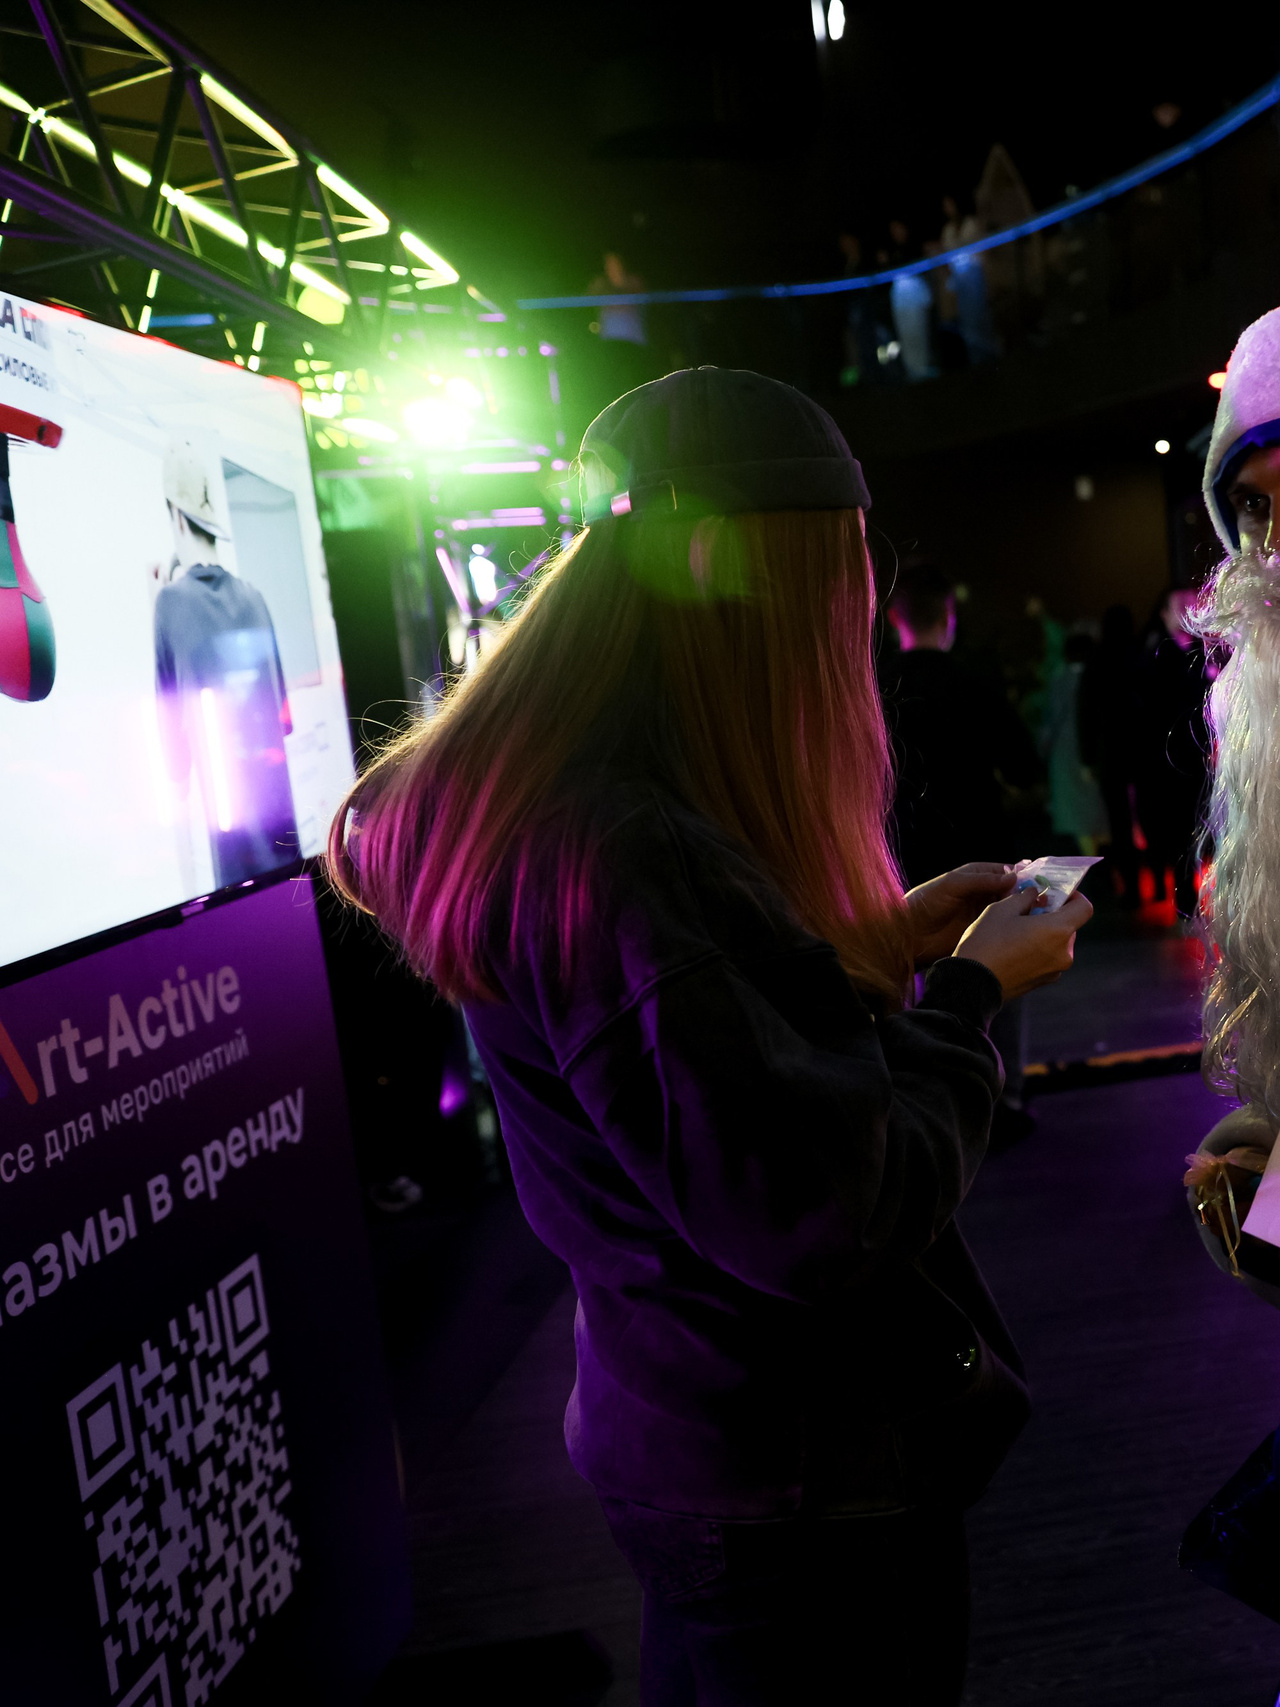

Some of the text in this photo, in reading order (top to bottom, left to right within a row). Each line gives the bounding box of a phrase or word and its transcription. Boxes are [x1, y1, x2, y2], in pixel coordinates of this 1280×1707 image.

[44, 1112, 95, 1168] для
[100, 1026, 250, 1132] мероприятий
[0, 1086, 305, 1328] азмы в аренду
